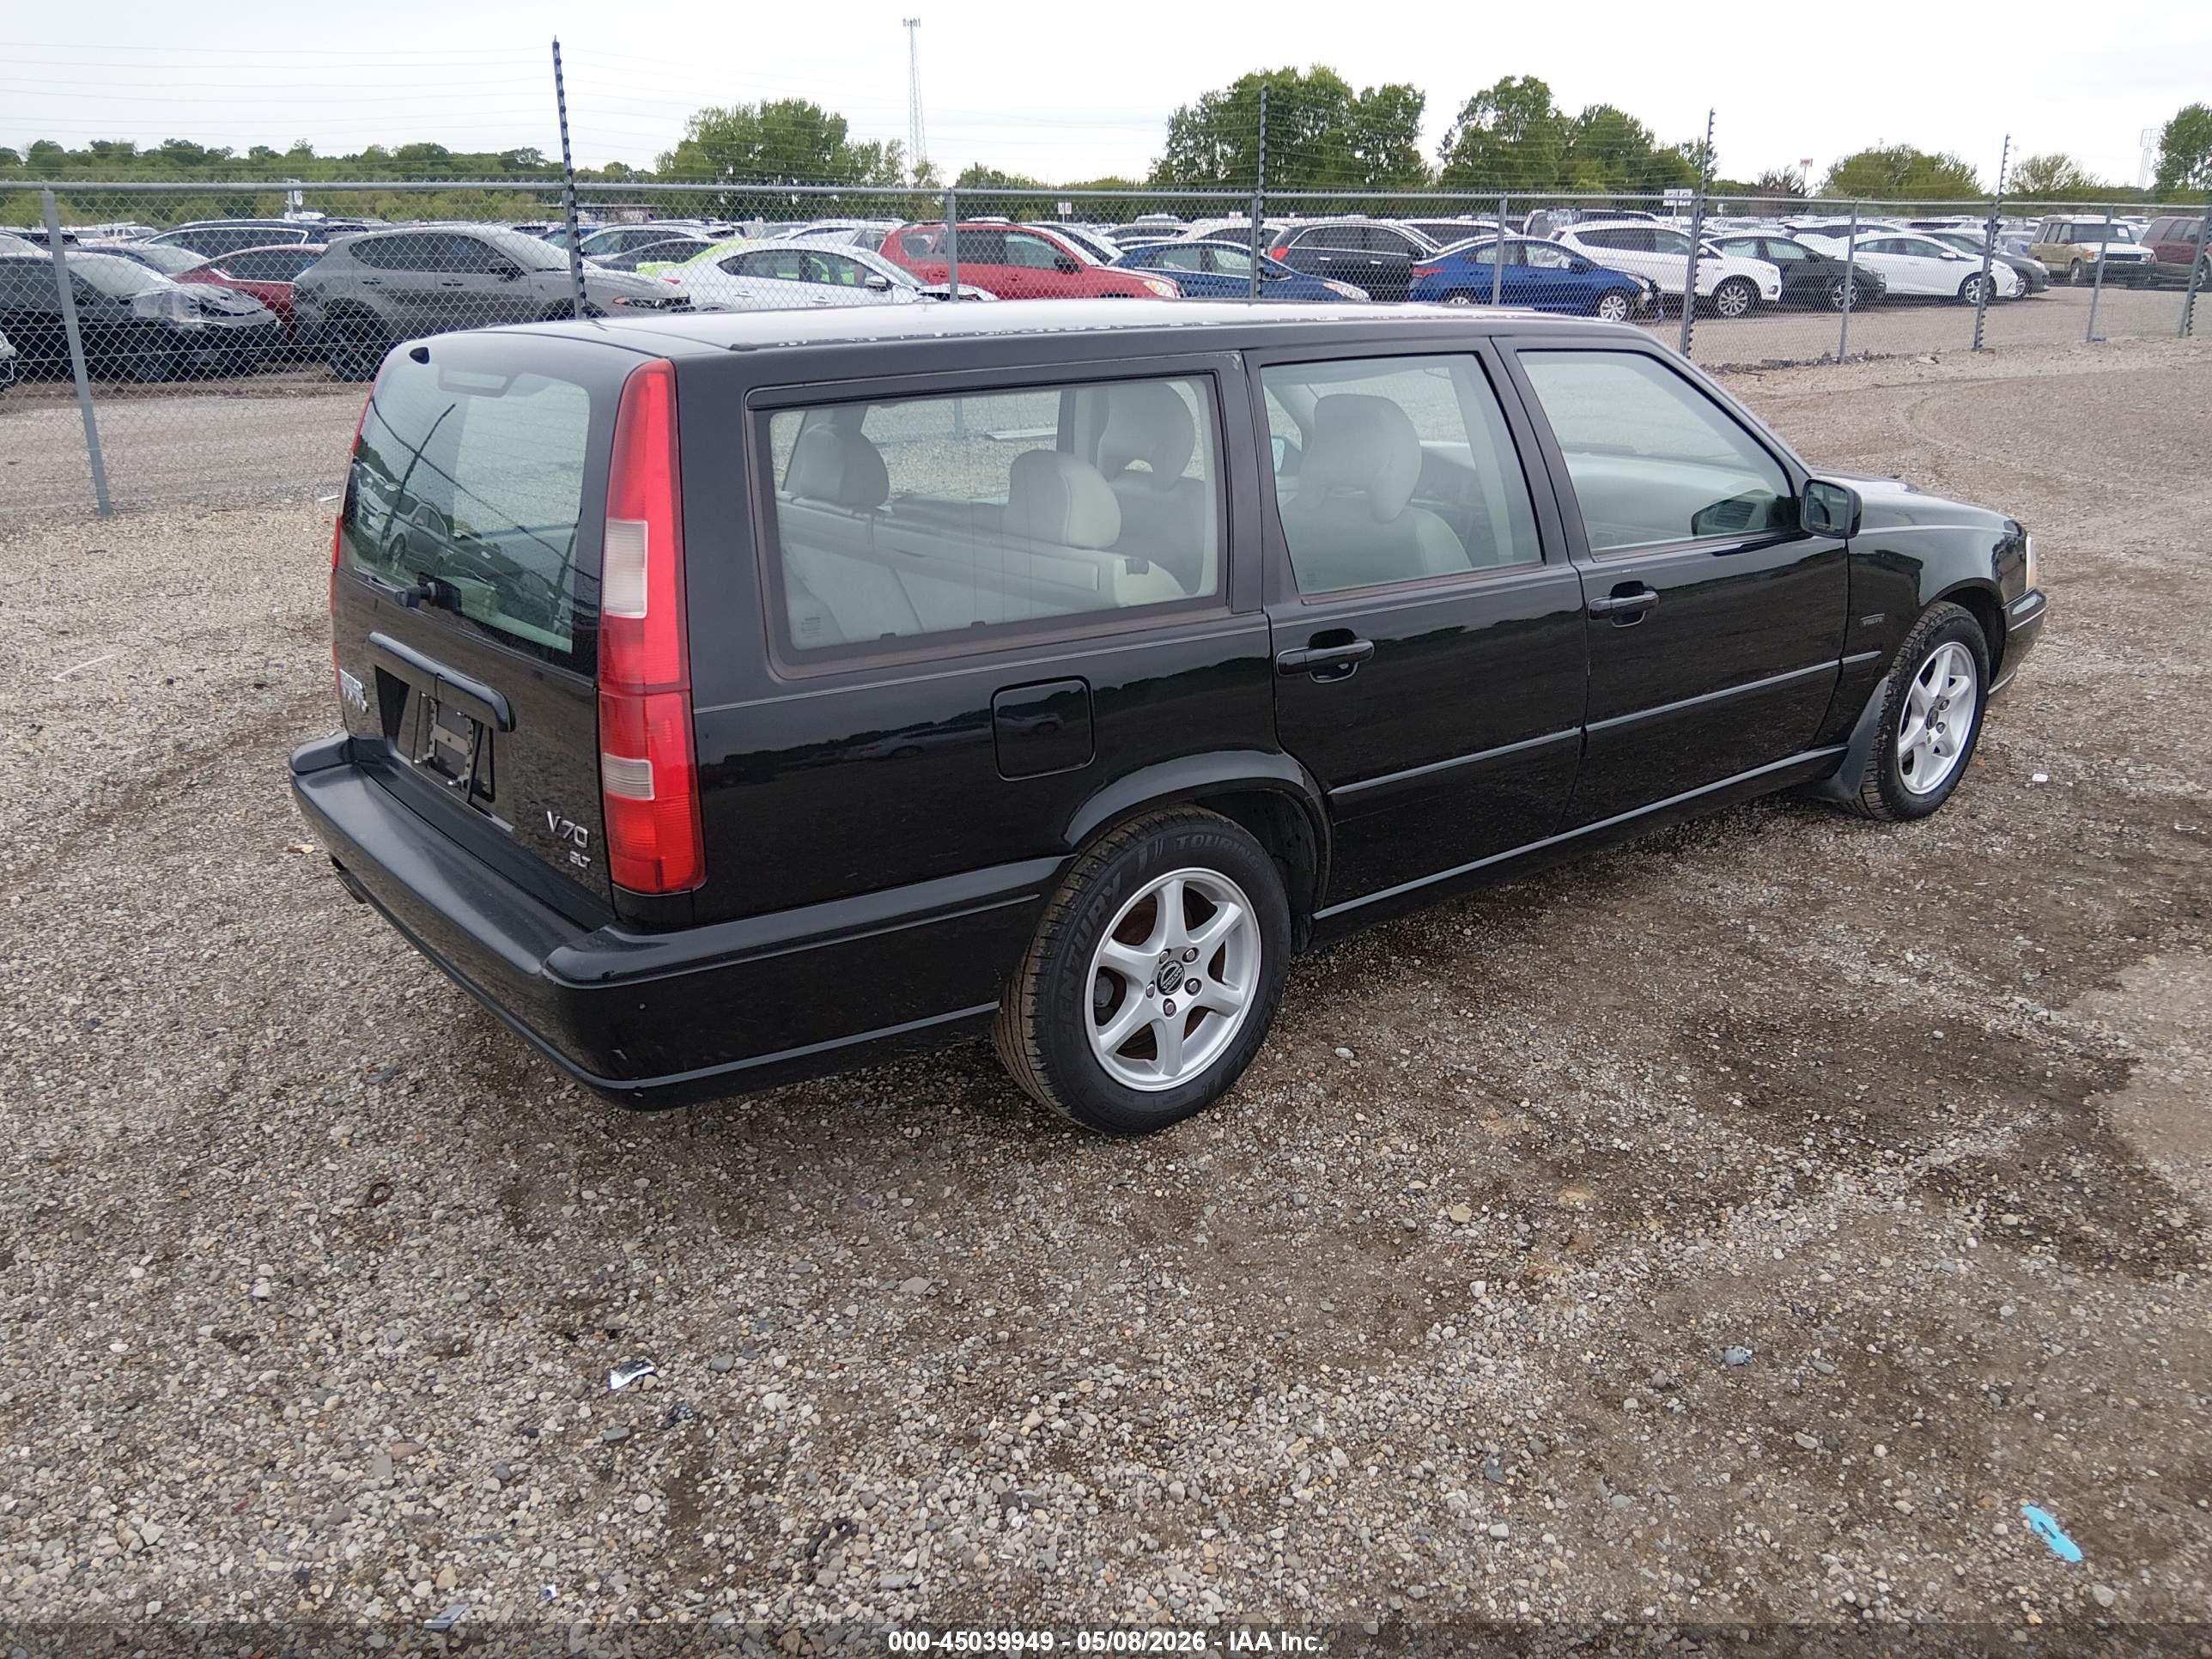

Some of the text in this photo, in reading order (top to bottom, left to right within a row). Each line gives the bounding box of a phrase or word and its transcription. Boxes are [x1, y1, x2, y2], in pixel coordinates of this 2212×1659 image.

[546, 810, 589, 848] V70
[1176, 833, 1259, 870] TOURING
[1161, 967, 1183, 990] VOLVO
